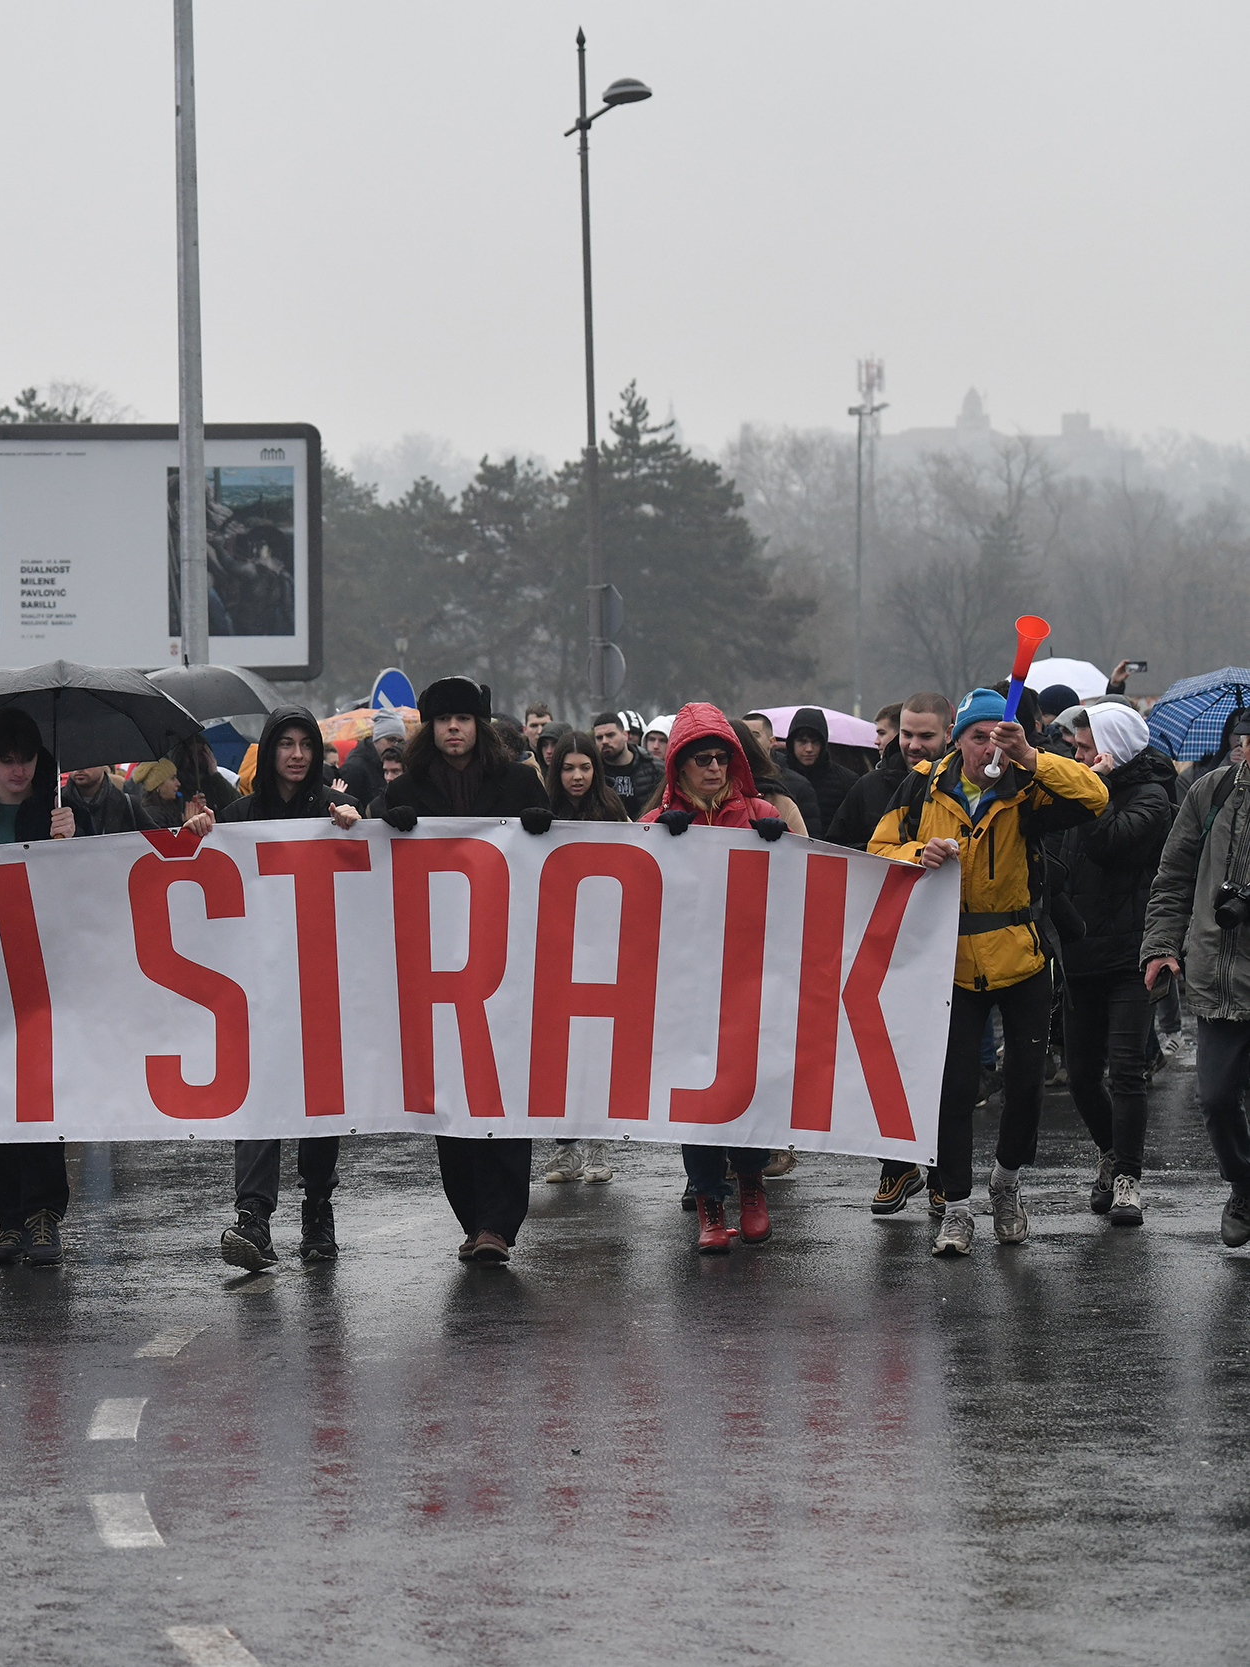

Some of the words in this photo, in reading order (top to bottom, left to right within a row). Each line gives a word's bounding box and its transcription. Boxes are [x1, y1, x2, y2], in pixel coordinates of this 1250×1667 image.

[20, 565, 70, 574] DUALNOST
[20, 577, 56, 586] MILENE
[20, 588, 67, 598] PAVLOVIĆ
[20, 600, 57, 609] BARILLI
[128, 828, 925, 1142] ŠTRAJK
